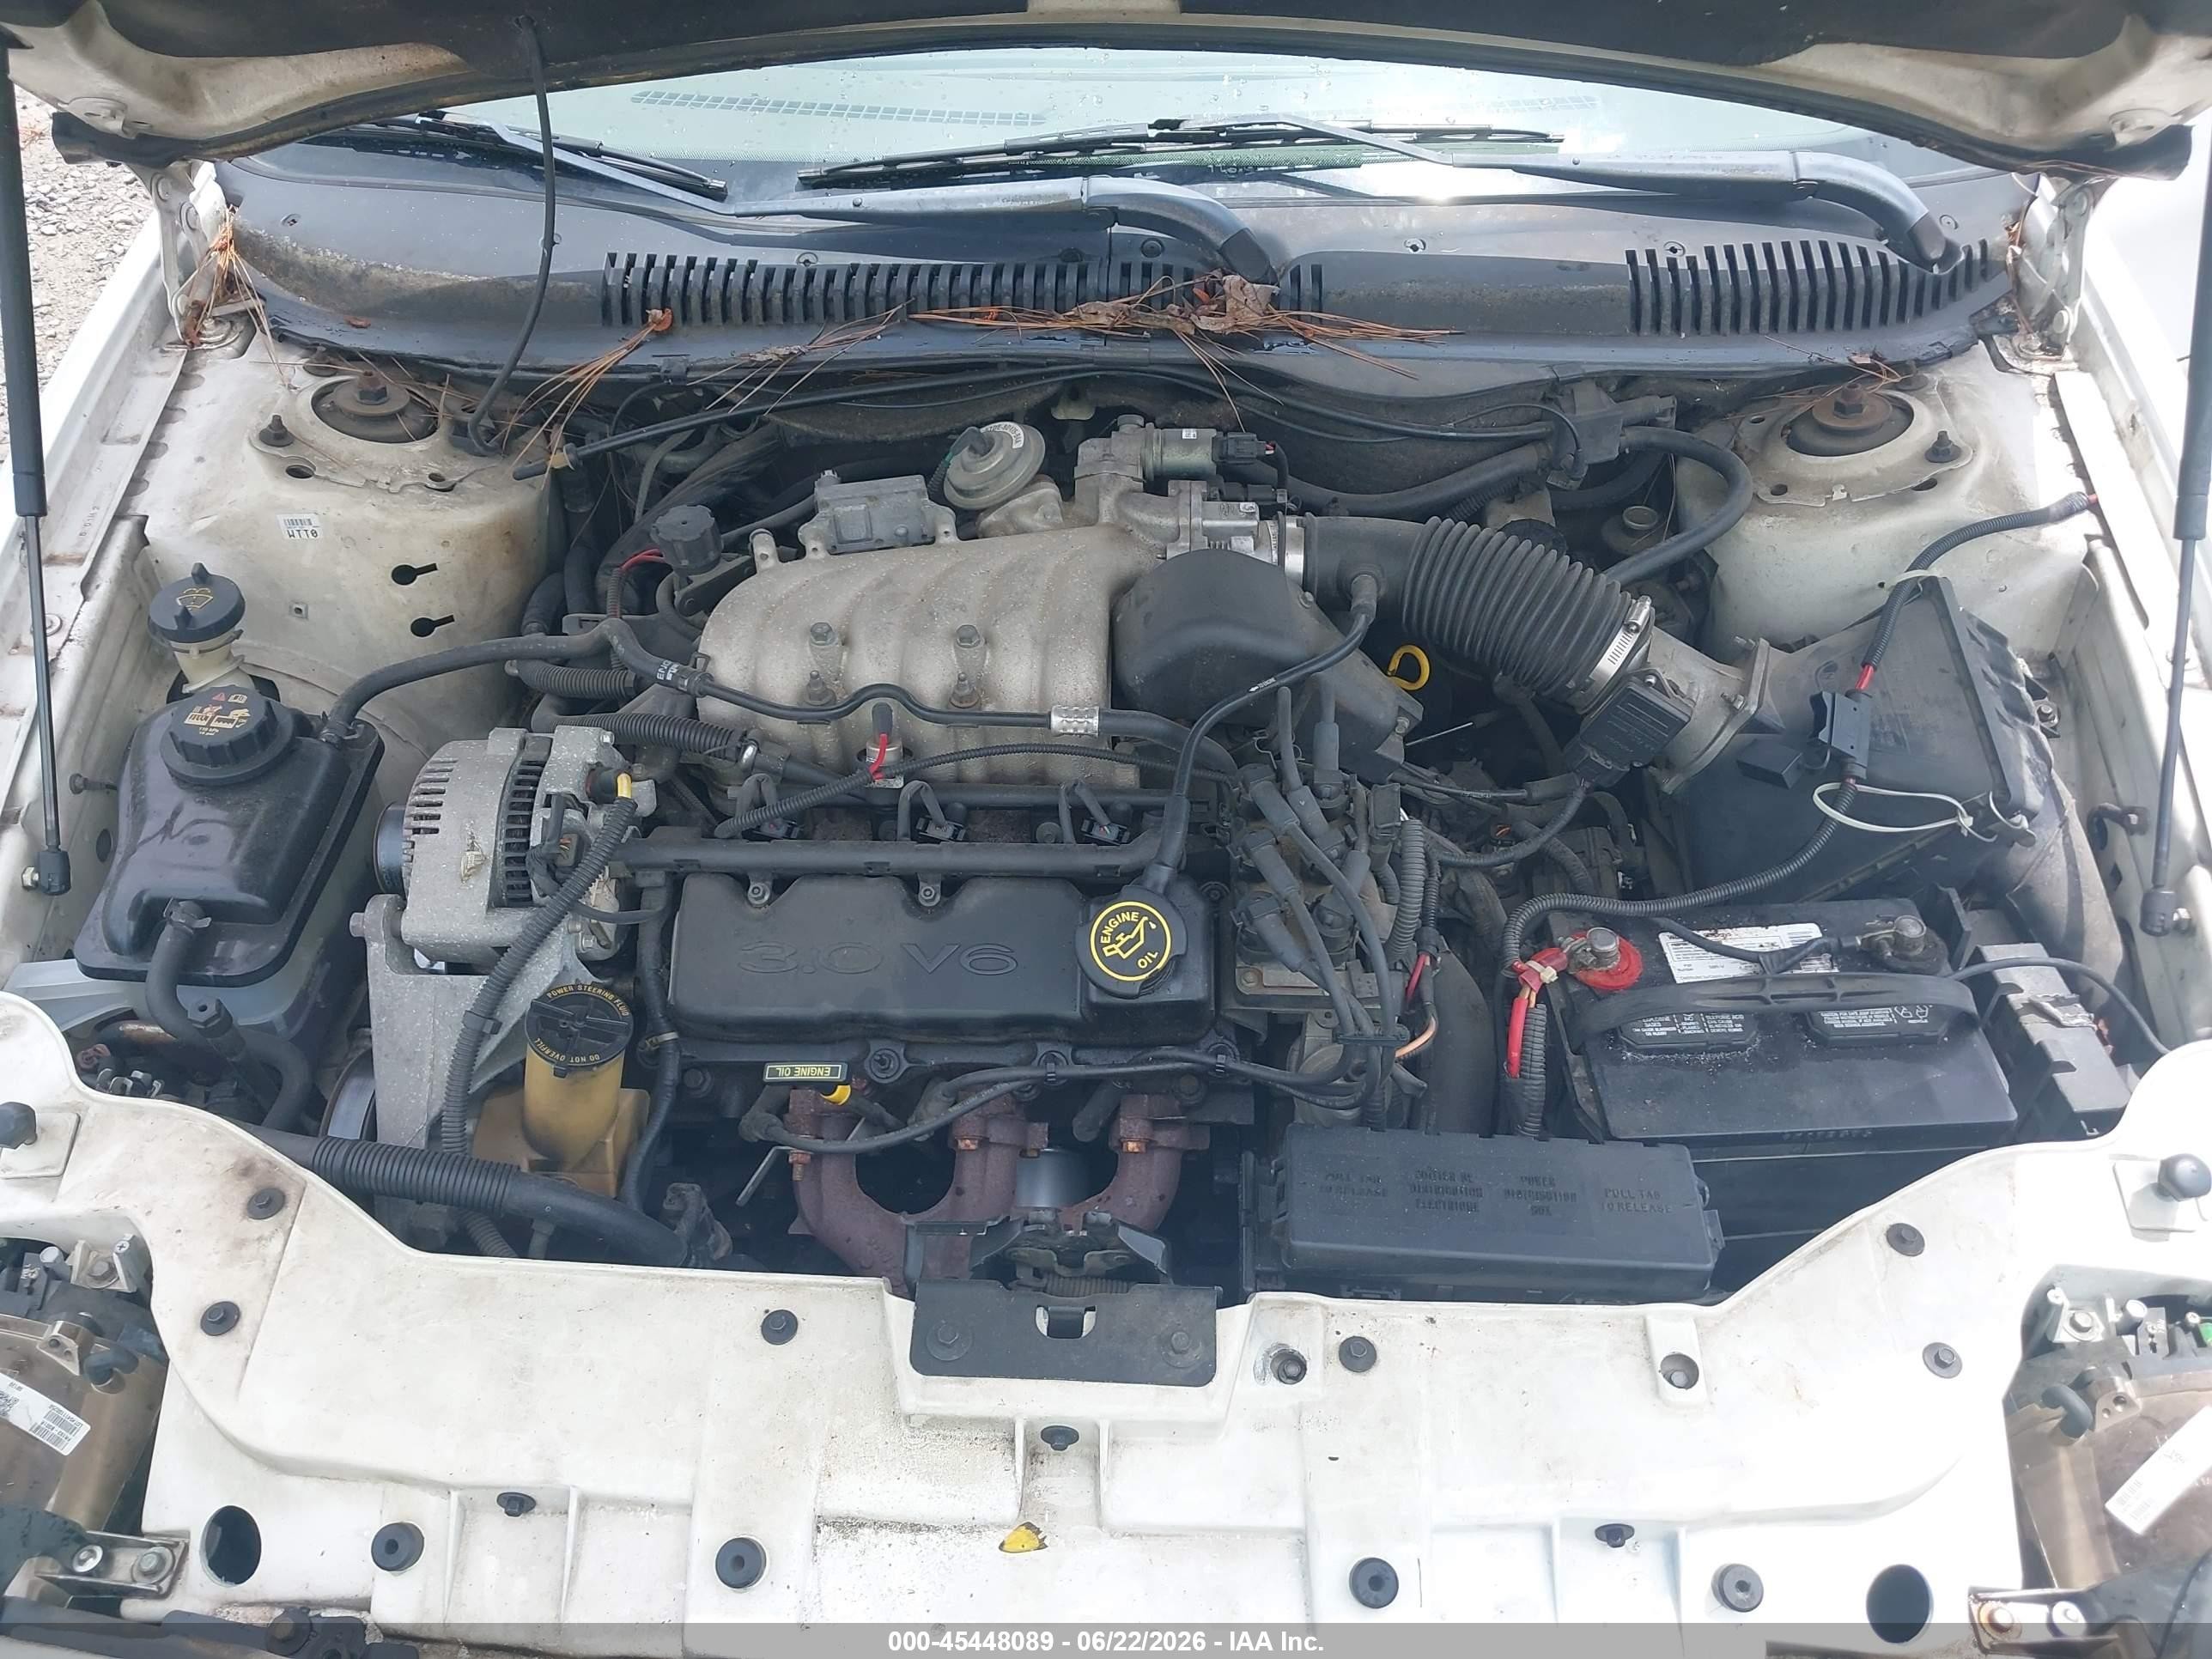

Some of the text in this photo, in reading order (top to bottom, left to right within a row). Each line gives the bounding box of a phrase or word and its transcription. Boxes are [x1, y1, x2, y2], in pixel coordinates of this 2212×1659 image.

[1100, 911, 1139, 944] ENGINE
[738, 940, 1018, 975] 3.0 V6
[1138, 951, 1158, 969] OIL
[546, 984, 629, 1017] POWER STEERING FLUID
[534, 1037, 566, 1061] OVERFILL
[775, 1066, 831, 1077] ENGINE OIL
[1604, 1188, 1661, 1200] PULL TAB
[1601, 1201, 1674, 1214] TO RELEASE
